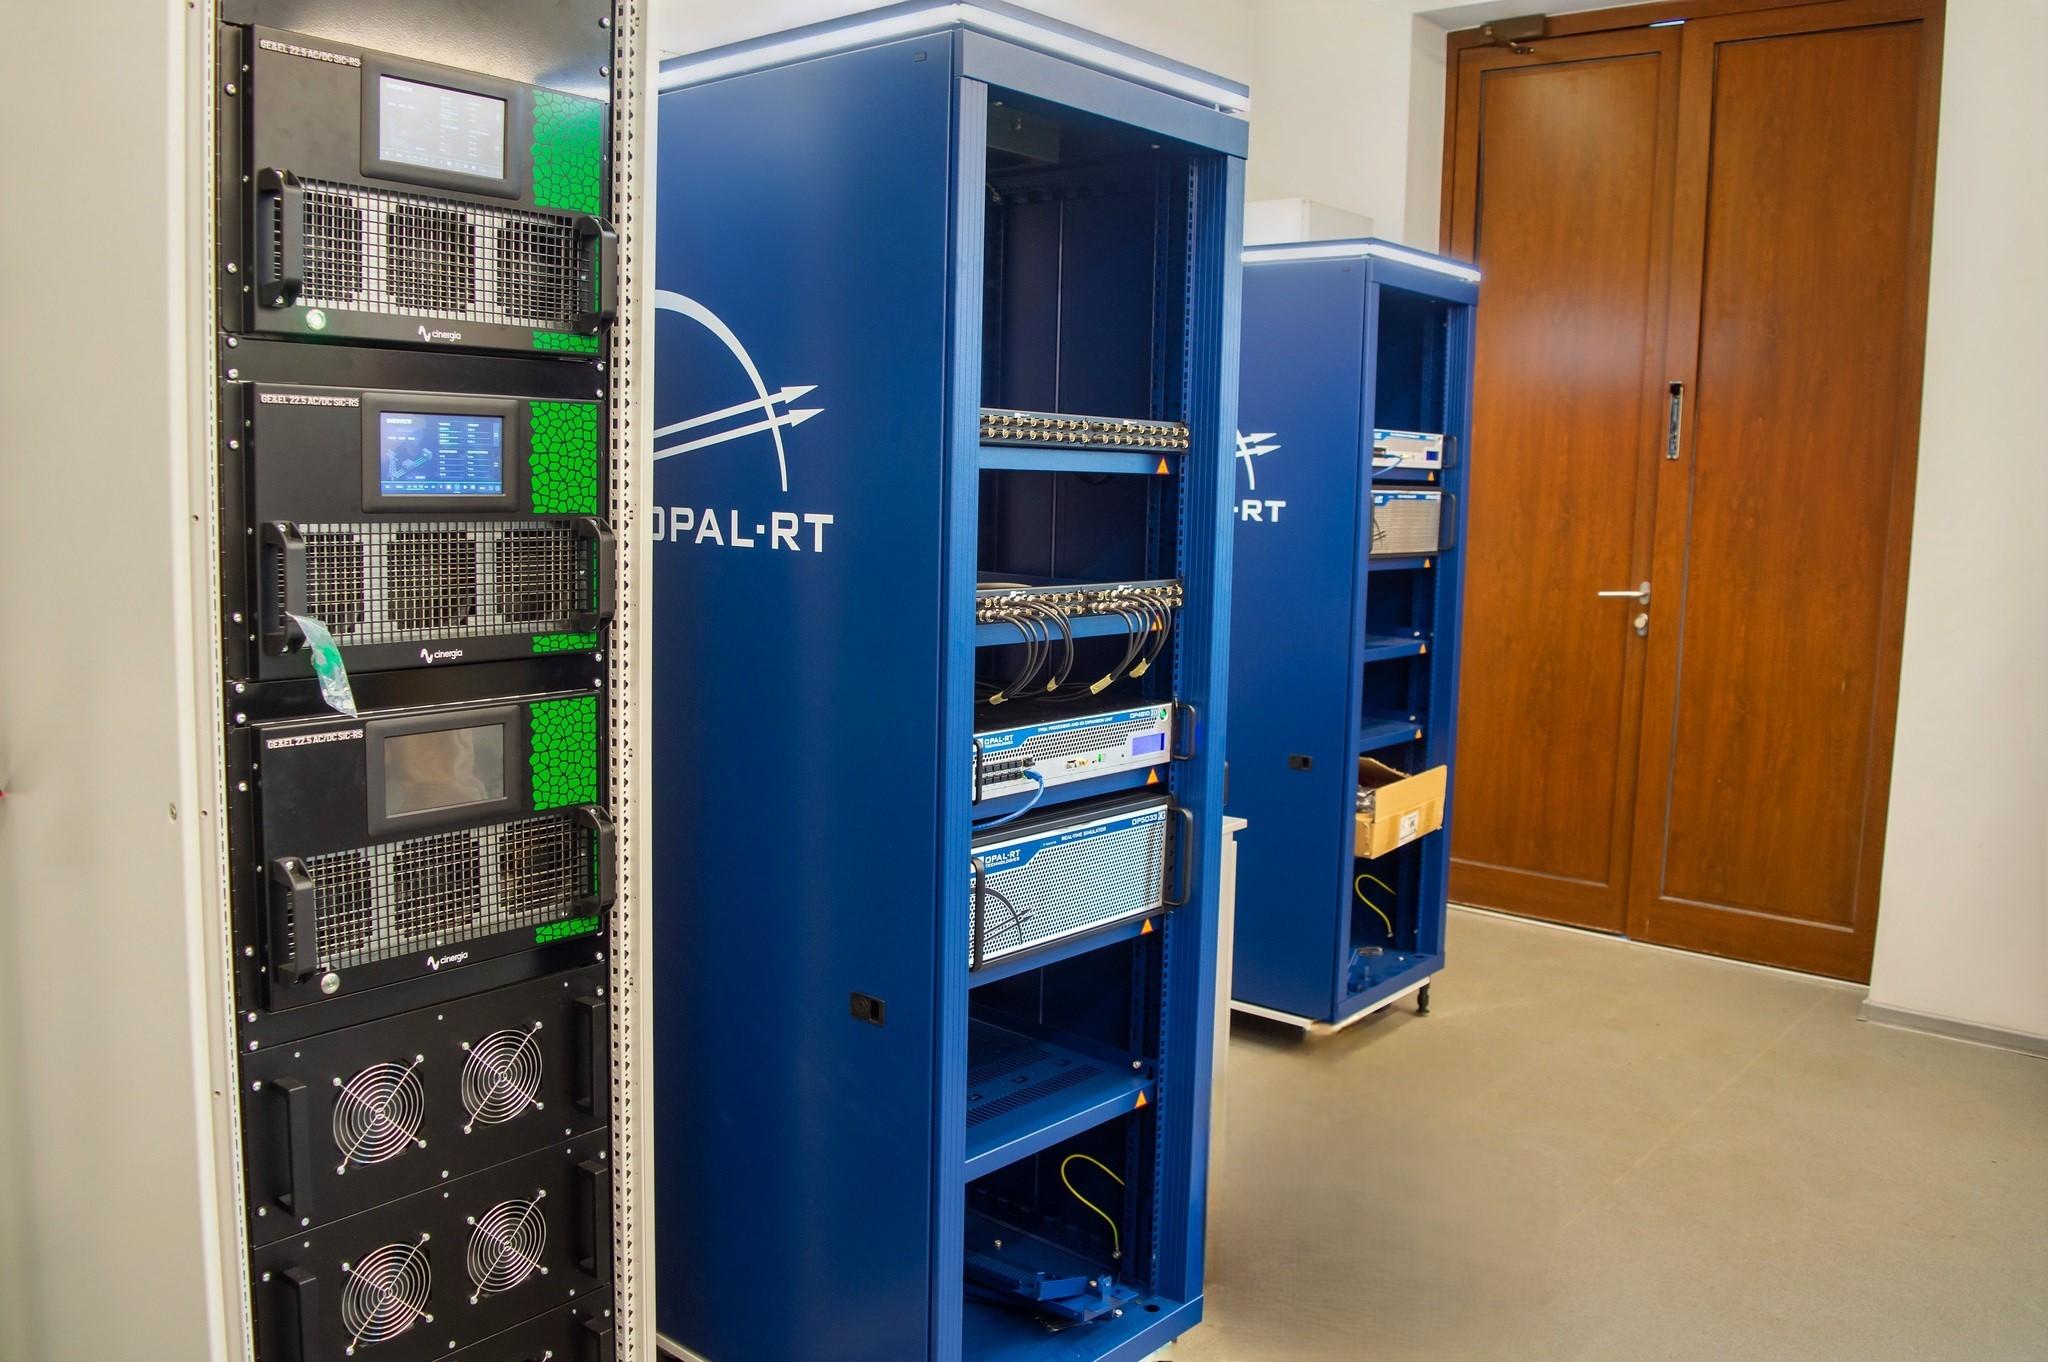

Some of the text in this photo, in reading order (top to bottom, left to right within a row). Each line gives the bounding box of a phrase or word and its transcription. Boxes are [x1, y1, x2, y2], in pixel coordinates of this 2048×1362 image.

[260, 39, 288, 53] GE&EL
[289, 45, 306, 57] 22.5
[307, 49, 333, 62] AC/DC
[431, 329, 462, 342] cinergia
[260, 394, 288, 404] GE&EL
[289, 395, 306, 405] 22.5
[307, 397, 332, 406] AC/DC
[434, 648, 463, 660] cinergia
[267, 739, 294, 749] GE&EL
[295, 736, 313, 746] 22.5
[313, 733, 338, 743] AC/DC
[440, 951, 468, 964] cinergia
